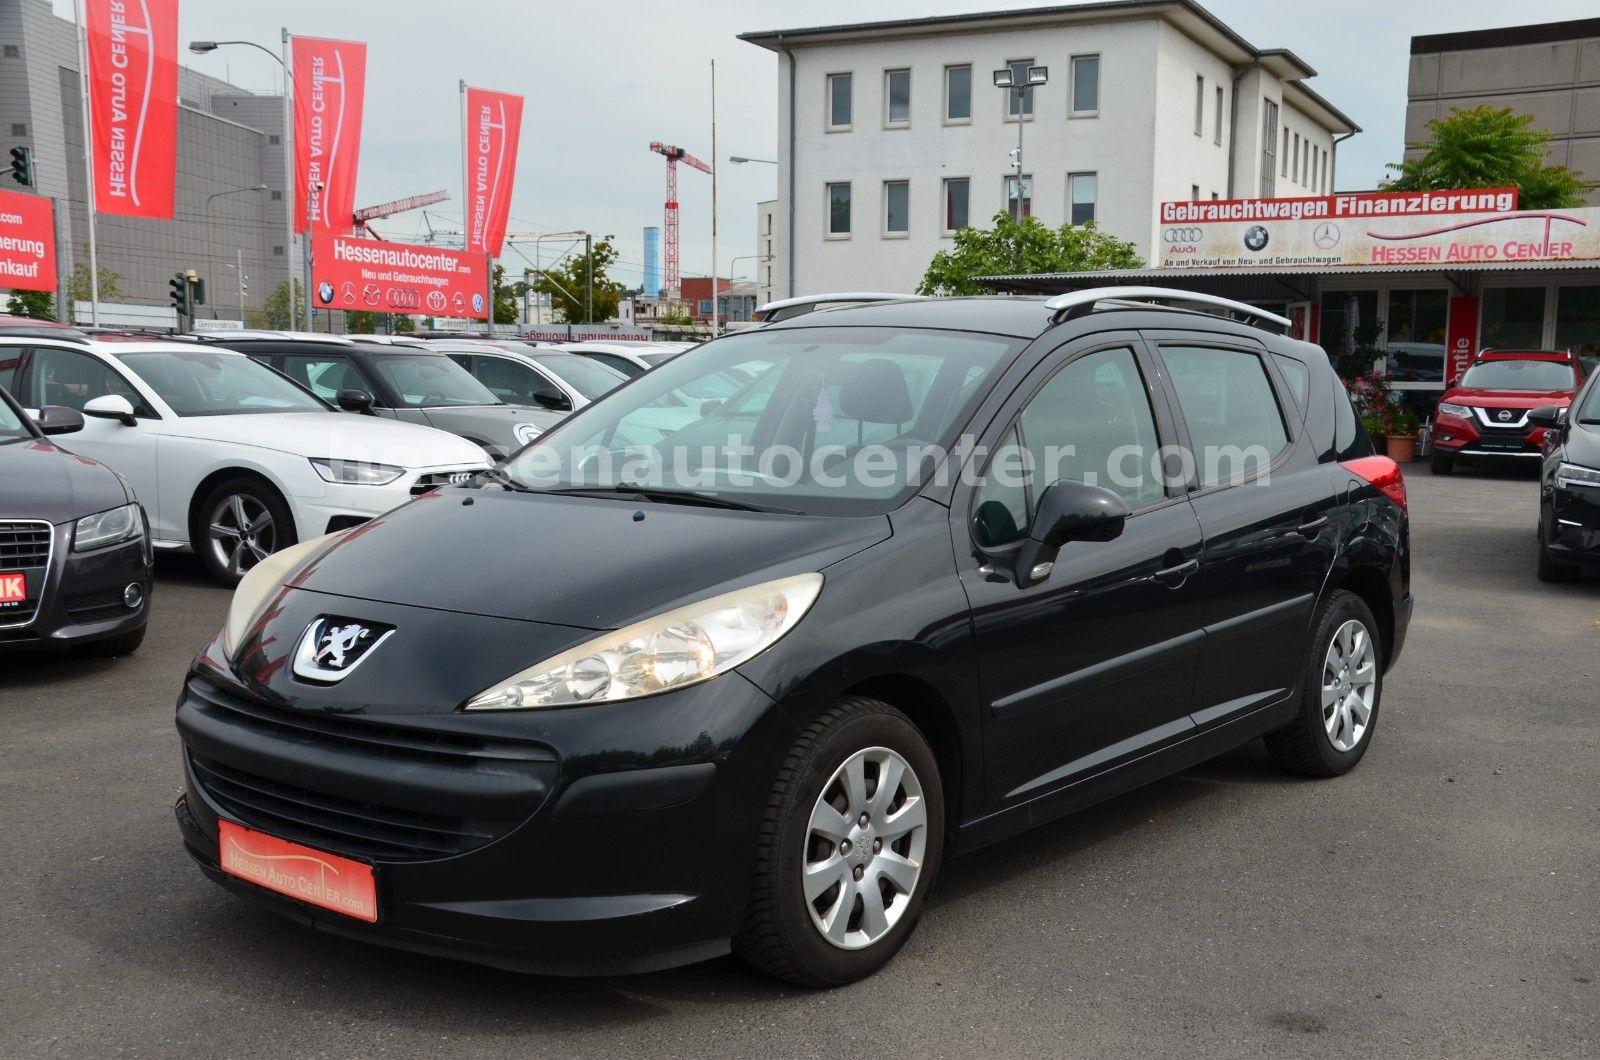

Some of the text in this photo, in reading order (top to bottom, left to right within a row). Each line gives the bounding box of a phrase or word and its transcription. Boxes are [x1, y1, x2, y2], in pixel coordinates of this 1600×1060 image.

[1163, 192, 1513, 220] Gebrauchtwagen Finanzierung
[333, 239, 471, 274] Hessenautocenter.com
[1164, 258, 1174, 266] An
[1176, 258, 1189, 266] und
[1192, 258, 1220, 266] Verkauf
[1238, 257, 1257, 265] Neu-
[1259, 256, 1273, 265] und
[1276, 255, 1341, 265] Gebrauchtwagen
[1371, 246, 1441, 262] HESSEN
[1446, 243, 1498, 261] AUTO
[361, 268, 449, 287] Neu und Gebrauchtwagen
[0, 577, 23, 598] K
[230, 851, 266, 878] HESSEN
[268, 866, 296, 889] AUTO
